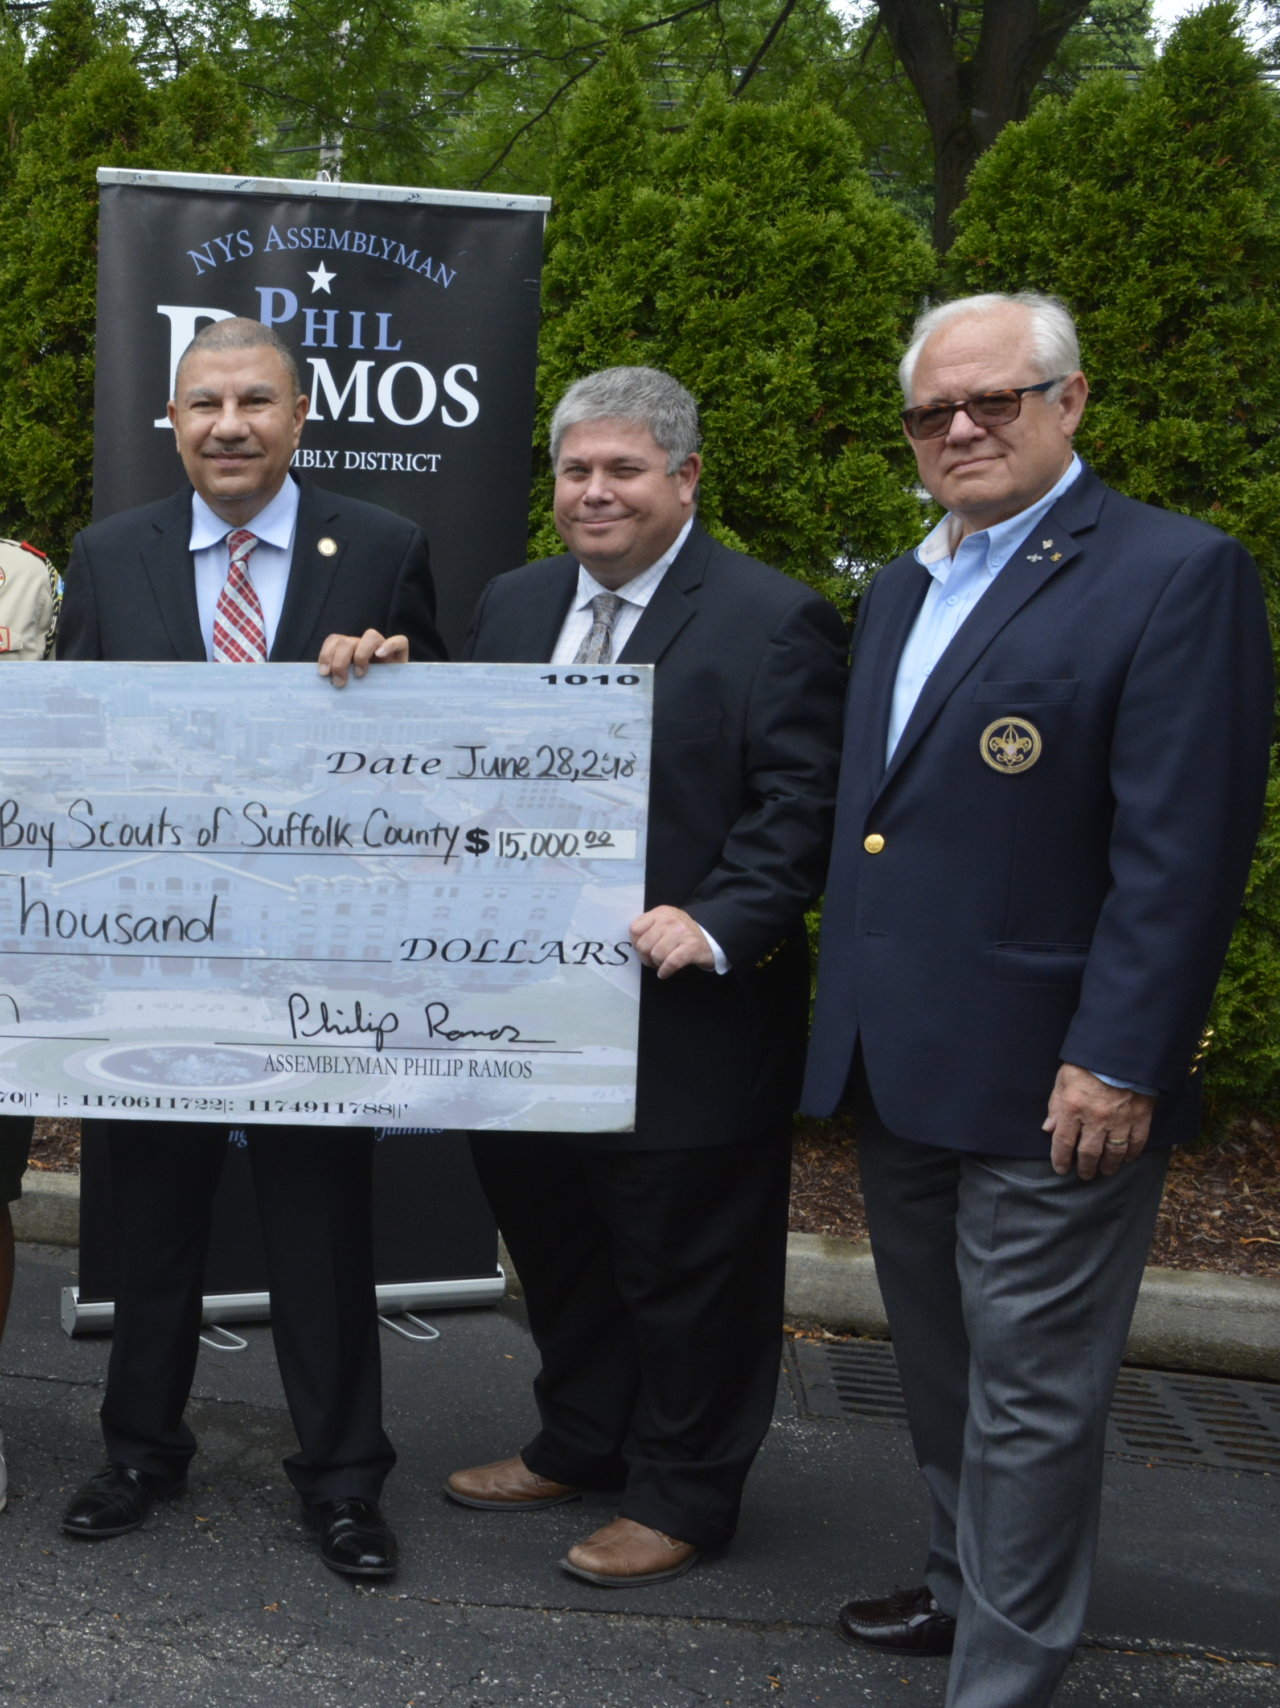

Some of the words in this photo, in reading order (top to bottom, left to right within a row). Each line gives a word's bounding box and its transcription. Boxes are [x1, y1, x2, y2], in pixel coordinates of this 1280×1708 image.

[186, 228, 255, 275] NYS
[263, 224, 457, 289] ASSEMBLYMAN
[255, 286, 402, 351] PHIL
[154, 305, 480, 428] RMOS
[344, 451, 441, 472] DISTRICT
[542, 674, 641, 686] 1010
[326, 751, 442, 776] Date
[452, 745, 531, 778] June
[68, 798, 184, 850] Scouts
[197, 806, 232, 848] of
[242, 801, 354, 850] Suffolk
[362, 807, 461, 866] County
[399, 937, 633, 968] DOLLARS
[288, 992, 400, 1053] Philip
[264, 1053, 398, 1077] ASSEMBLYMAN
[403, 1057, 463, 1078] PHILIP
[467, 1058, 533, 1079] RAMOS
